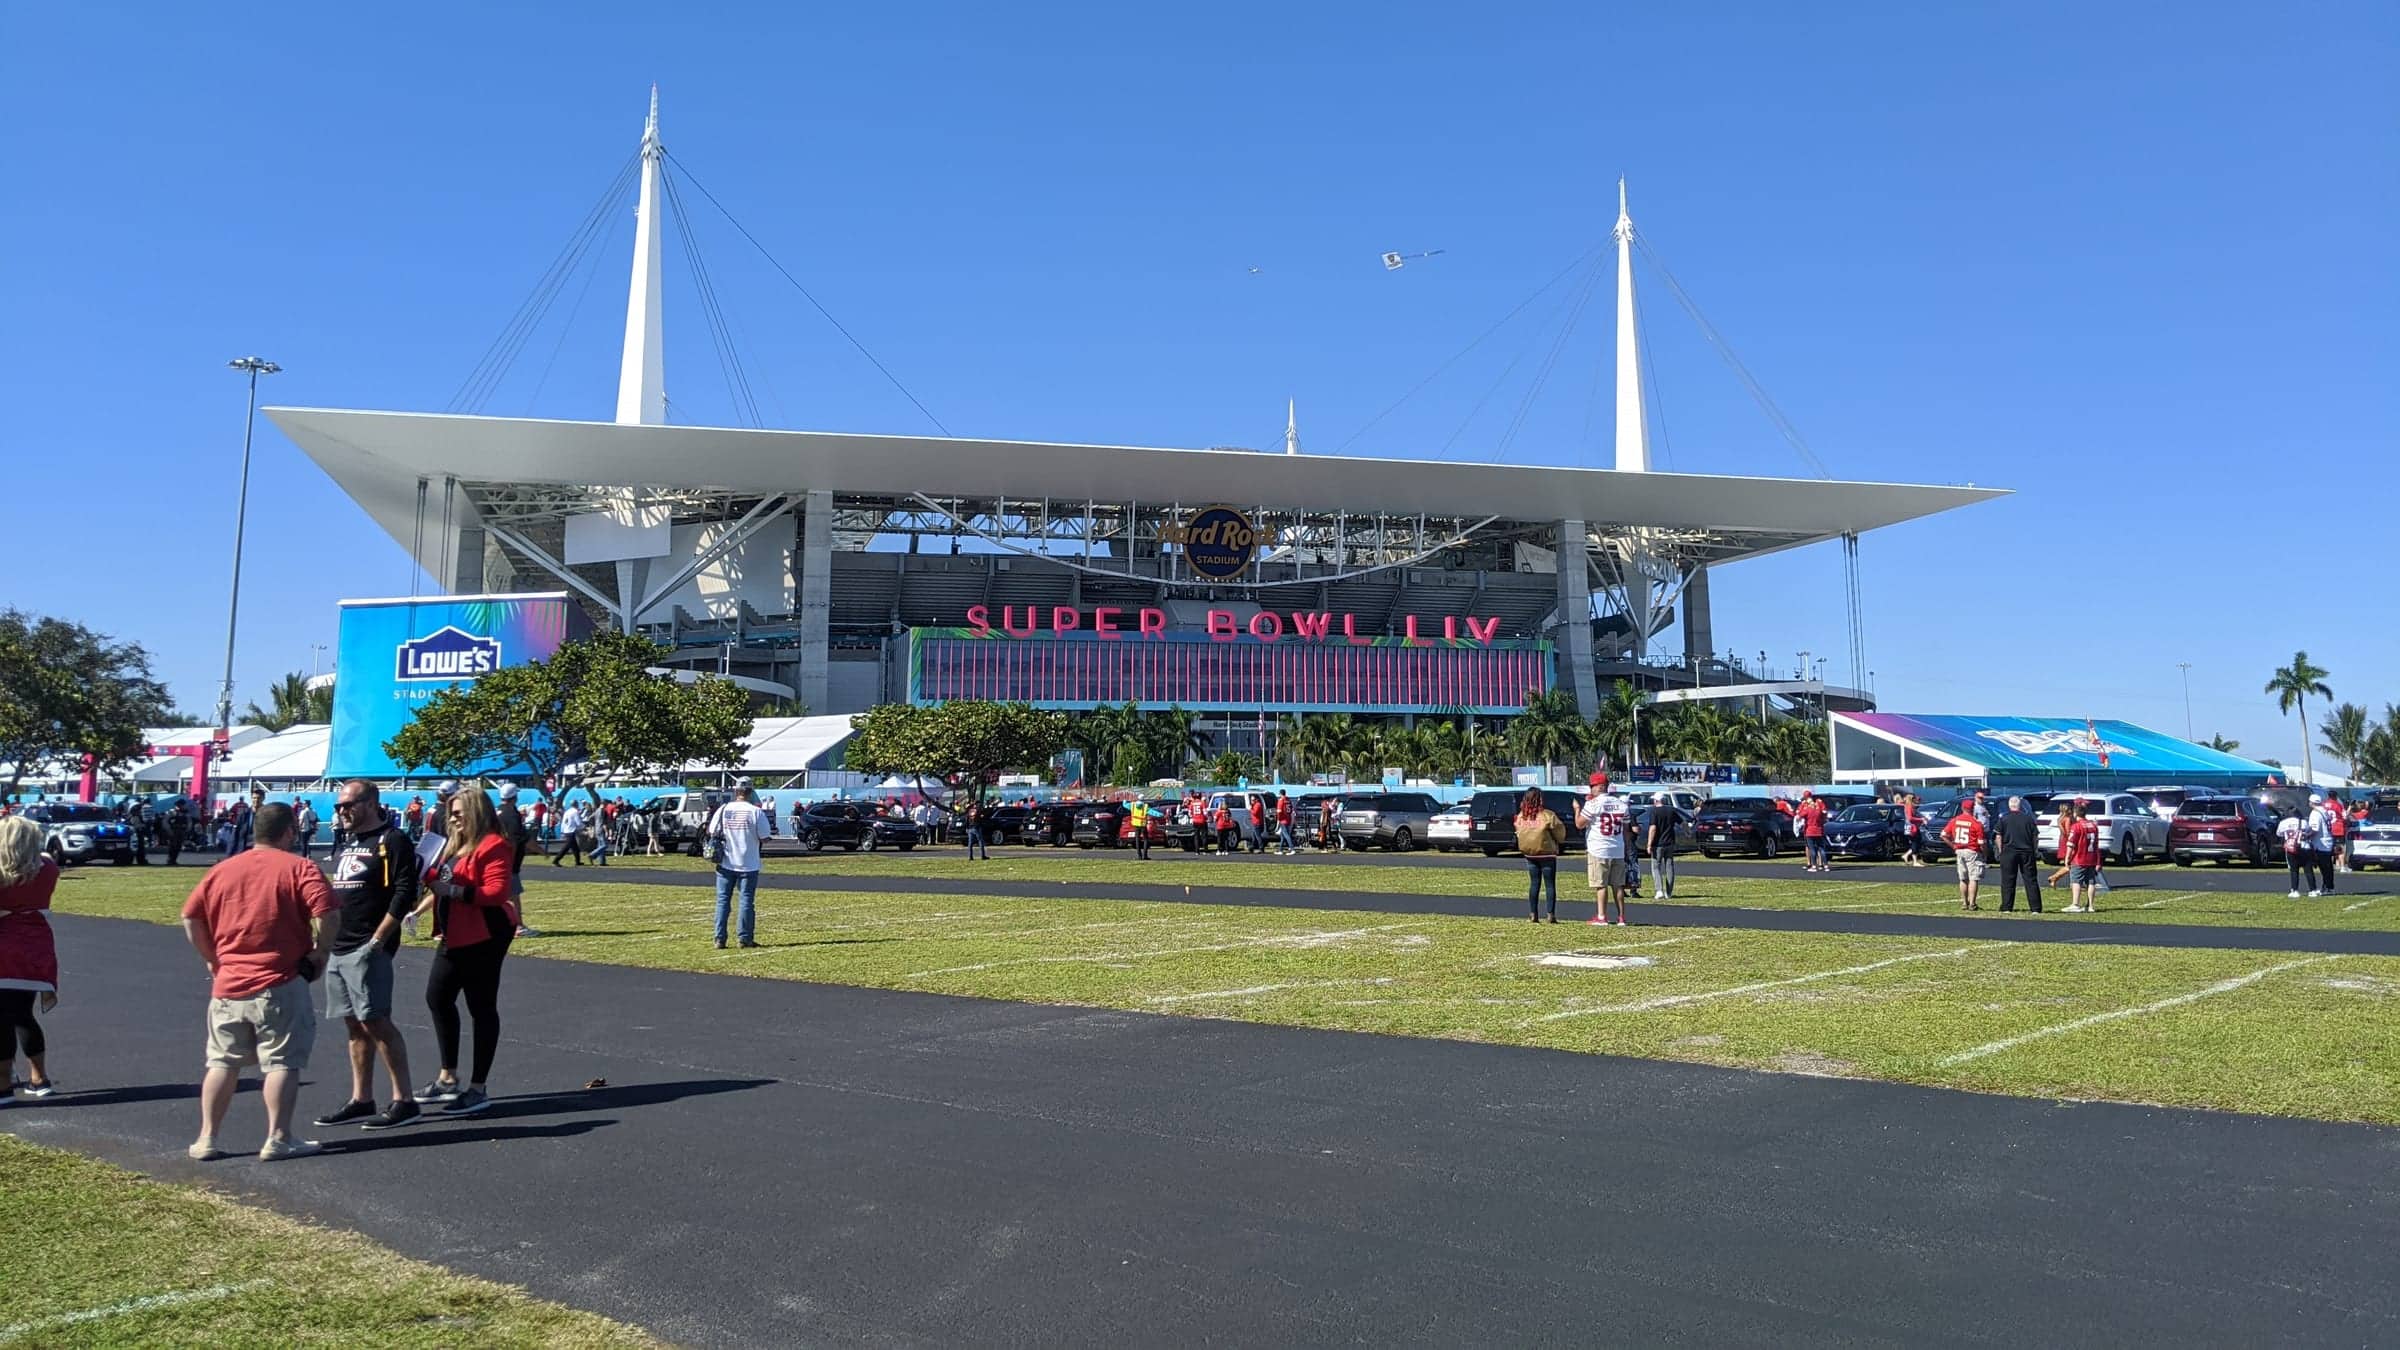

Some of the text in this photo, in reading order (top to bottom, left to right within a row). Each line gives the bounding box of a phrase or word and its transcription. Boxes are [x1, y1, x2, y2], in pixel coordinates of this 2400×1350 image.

[1158, 520, 1276, 551] Hard Rock
[1196, 555, 1240, 565] STADIUM
[967, 605, 1500, 646] SUPER BOWL LIV
[407, 646, 493, 675] LOWE'S
[1600, 812, 1624, 836] 85
[1955, 826, 1970, 844] 15
